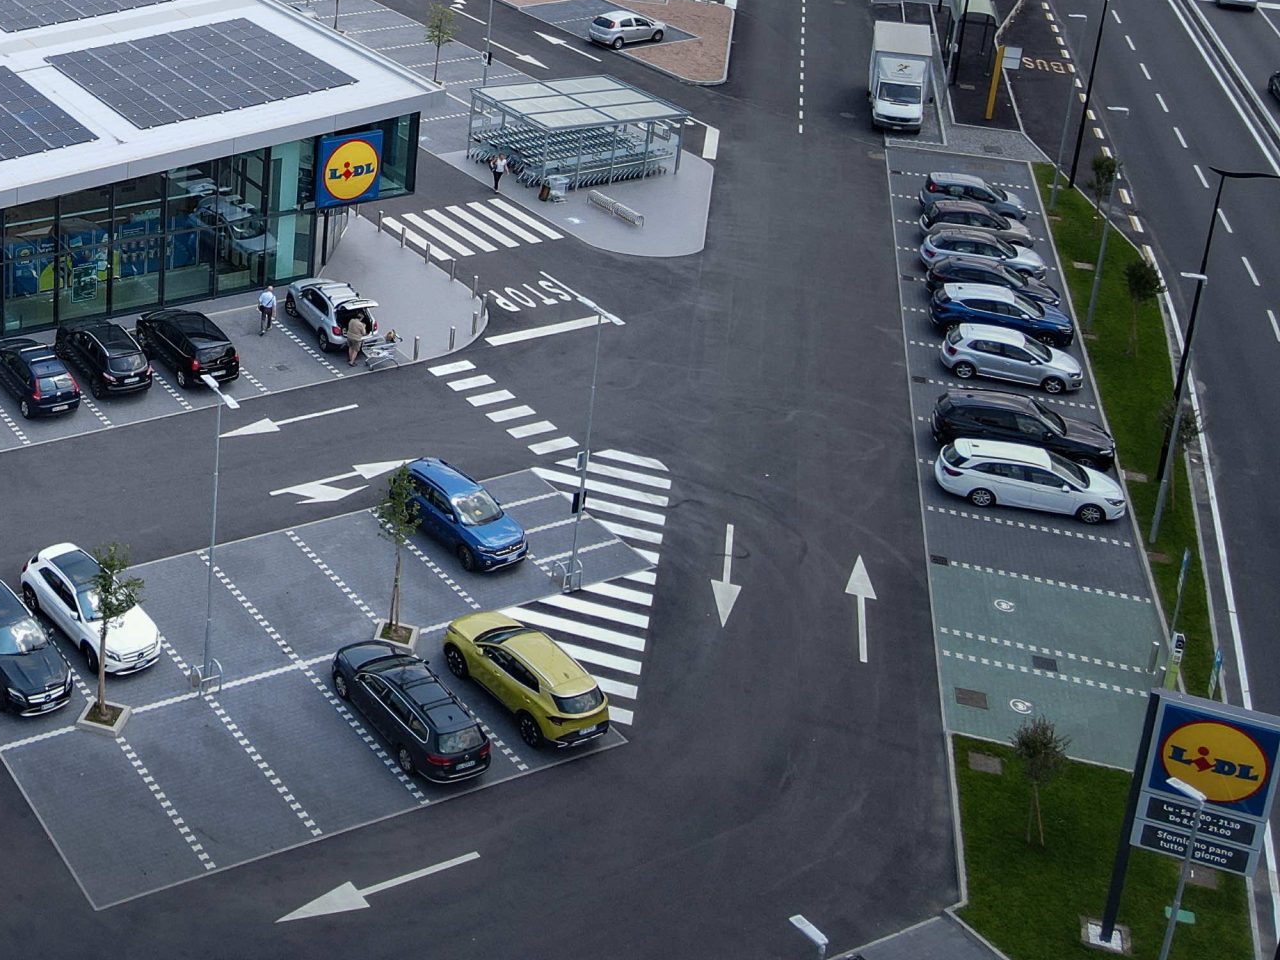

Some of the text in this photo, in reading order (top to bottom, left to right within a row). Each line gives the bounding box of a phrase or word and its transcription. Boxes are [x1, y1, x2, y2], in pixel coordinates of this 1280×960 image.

[1022, 56, 1066, 74] BUS
[488, 280, 572, 312] STOP
[1163, 804, 1174, 812] Lu
[1181, 808, 1191, 817] Sa
[1218, 819, 1241, 830] 21.30
[1169, 814, 1180, 823] Do
[1208, 825, 1231, 836] 21.00
[1160, 841, 1227, 864] tutto giorno
[1209, 845, 1233, 858] pane
